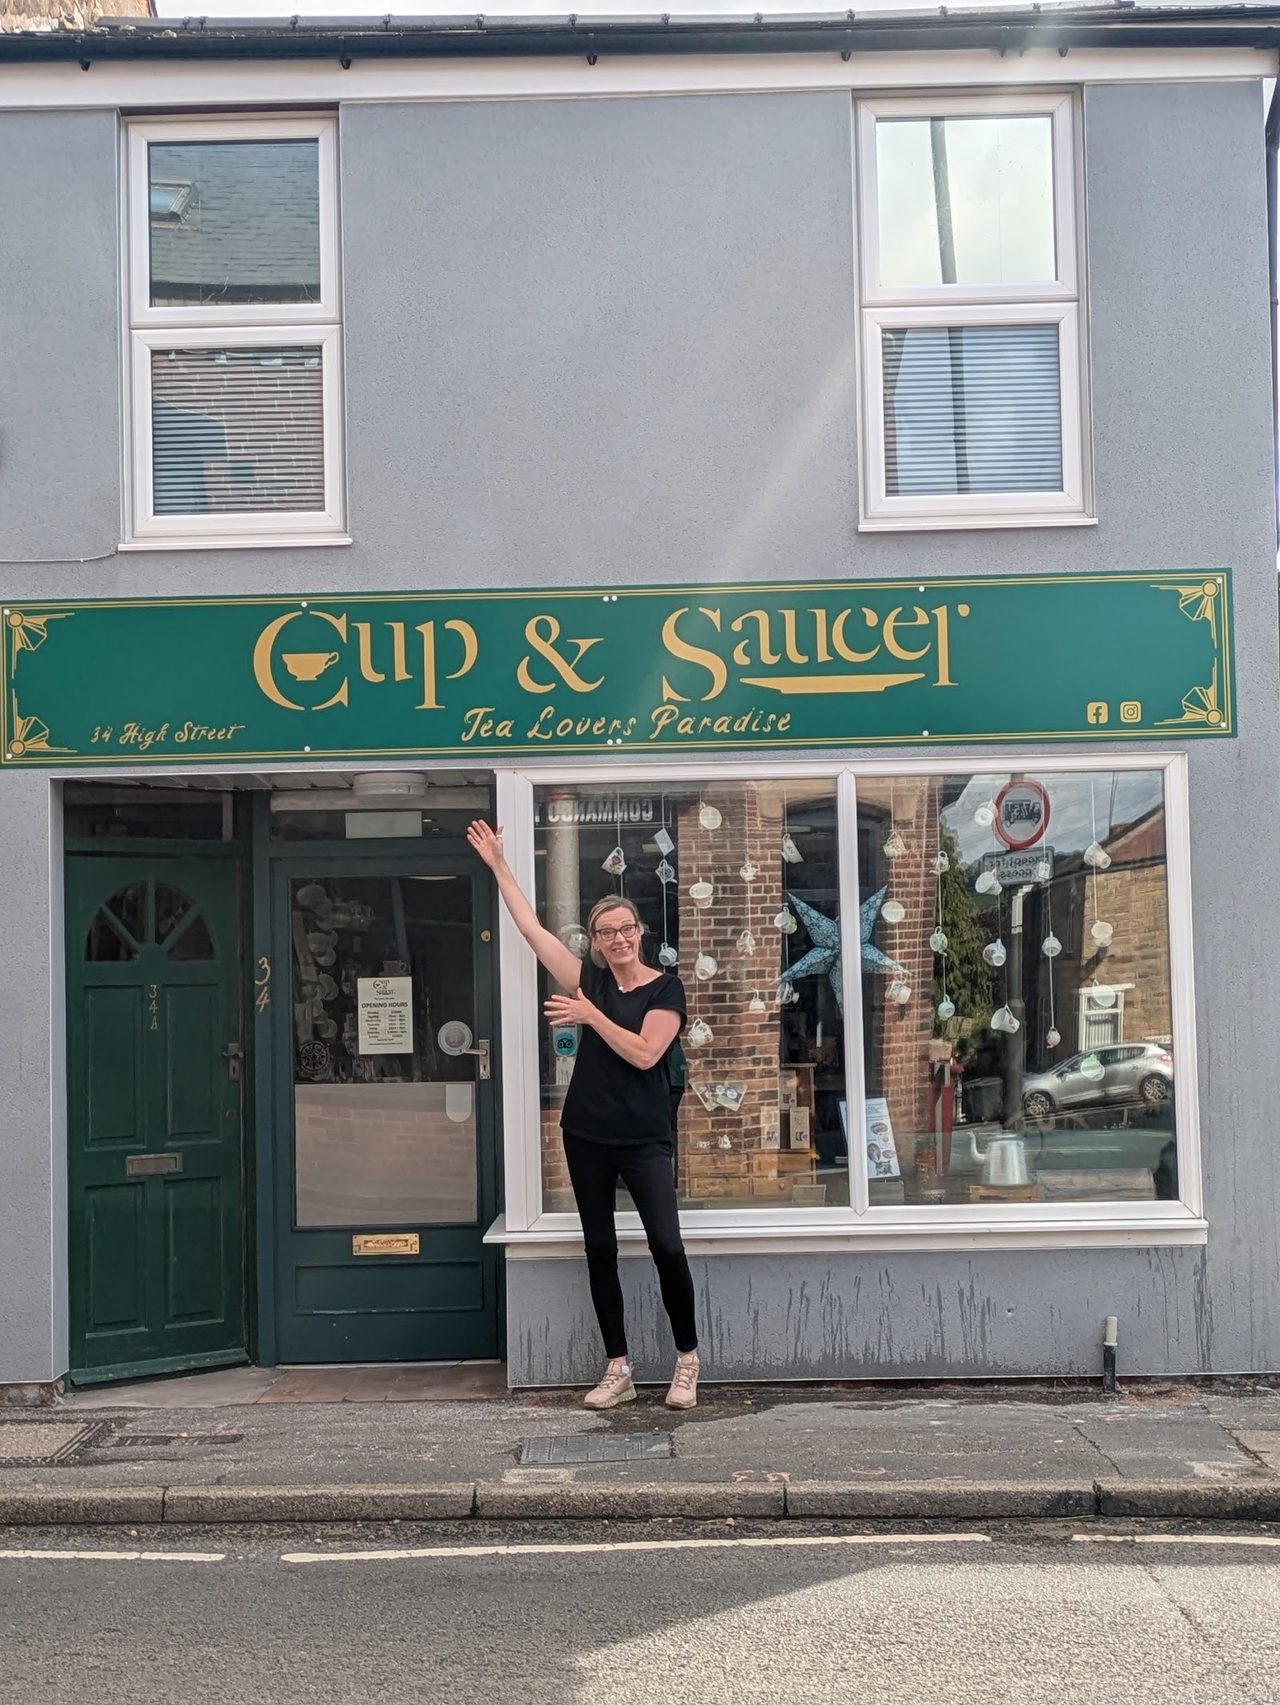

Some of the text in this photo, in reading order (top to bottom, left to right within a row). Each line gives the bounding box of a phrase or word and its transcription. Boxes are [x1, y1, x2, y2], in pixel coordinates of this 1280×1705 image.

[253, 603, 971, 711] Cup & Saucer
[91, 720, 246, 751] 34 High Street
[461, 704, 792, 741] Tea Lovers Paradise
